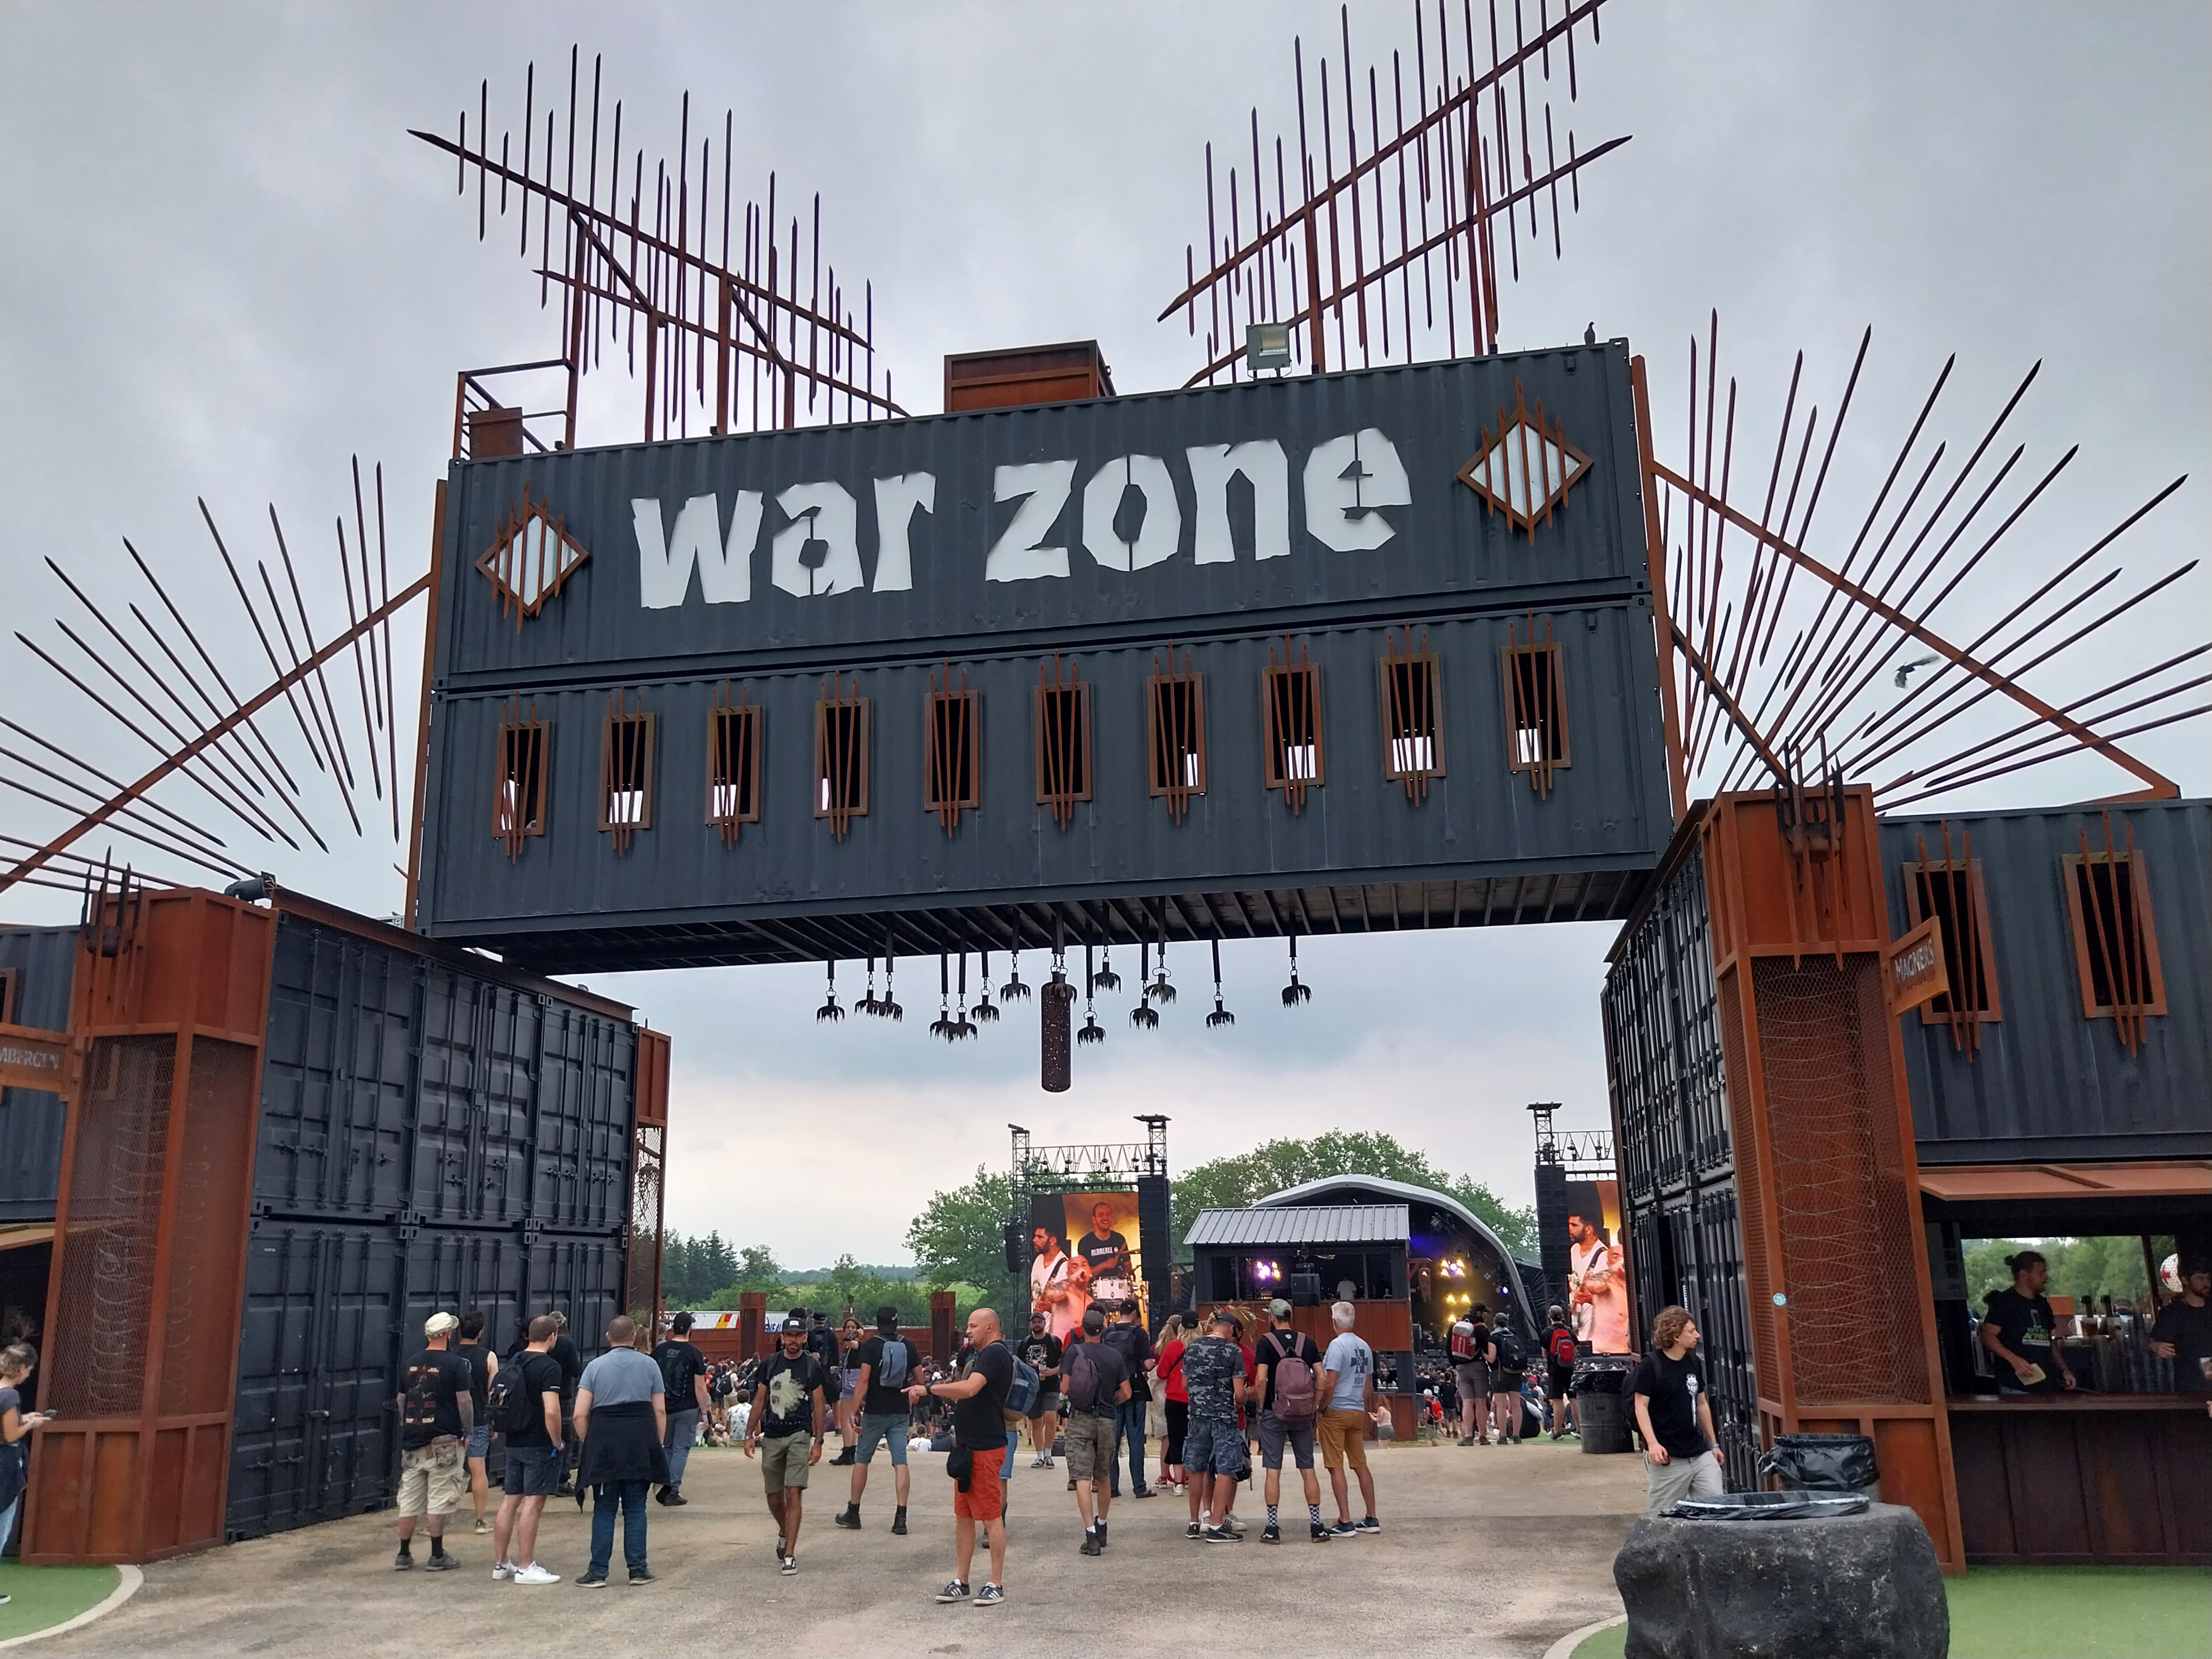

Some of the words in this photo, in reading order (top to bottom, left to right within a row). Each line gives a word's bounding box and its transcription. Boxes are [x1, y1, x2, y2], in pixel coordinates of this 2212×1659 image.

[632, 472, 935, 609] war
[985, 428, 1412, 582] zone
[1894, 938, 1934, 983] MAGNERS
